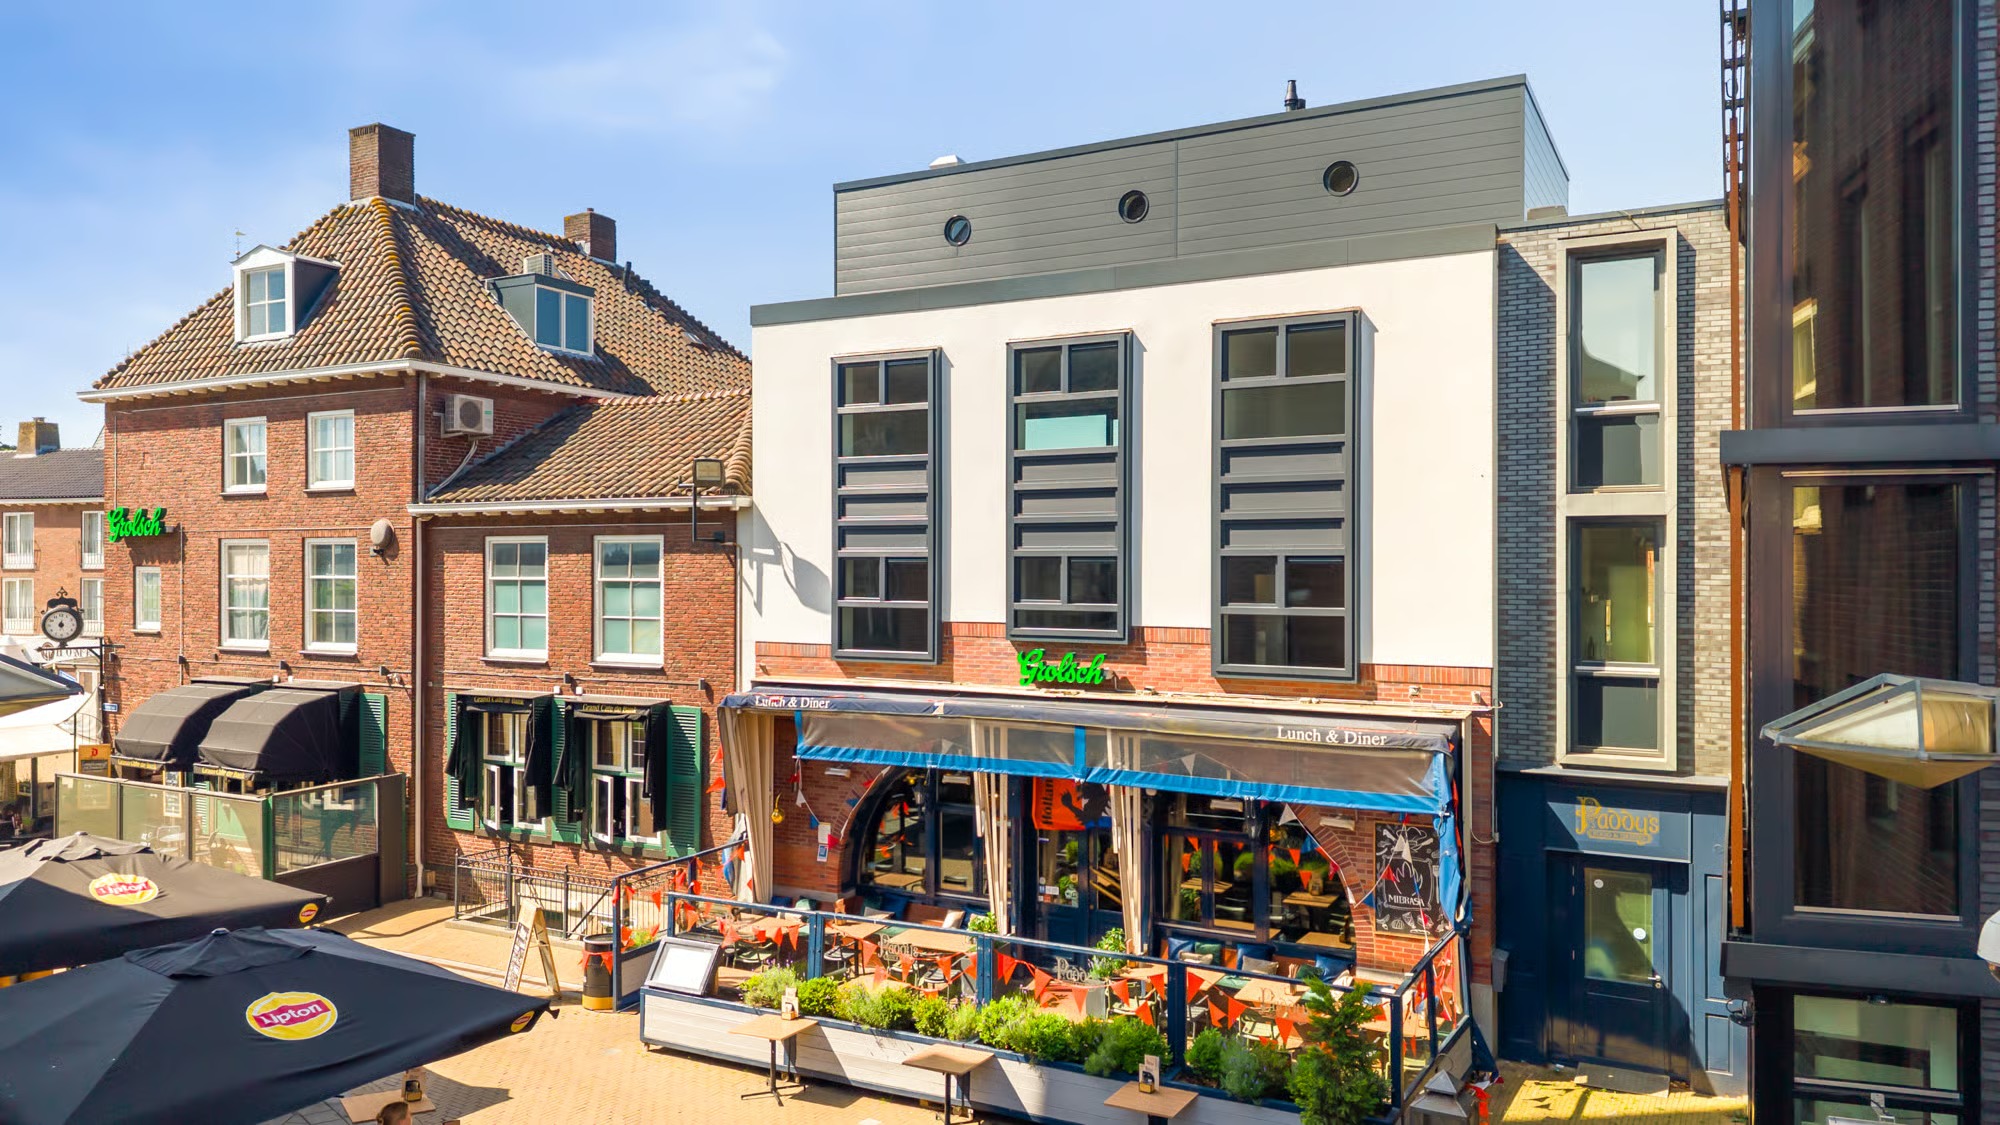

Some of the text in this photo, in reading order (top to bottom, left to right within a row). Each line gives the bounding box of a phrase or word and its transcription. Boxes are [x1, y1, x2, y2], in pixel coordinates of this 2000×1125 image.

[107, 507, 163, 542] Grolsch
[1017, 649, 1106, 687] Grolsch
[788, 696, 798, 708] &
[800, 697, 831, 709] Diner
[1277, 726, 1387, 746] Lunch & Diner
[1041, 779, 1053, 825] Hollan
[1575, 796, 1659, 835] Paddy's
[99, 883, 147, 895] Lipton
[1388, 894, 1425, 907] MIBRASA
[260, 1004, 322, 1024] Lipton
